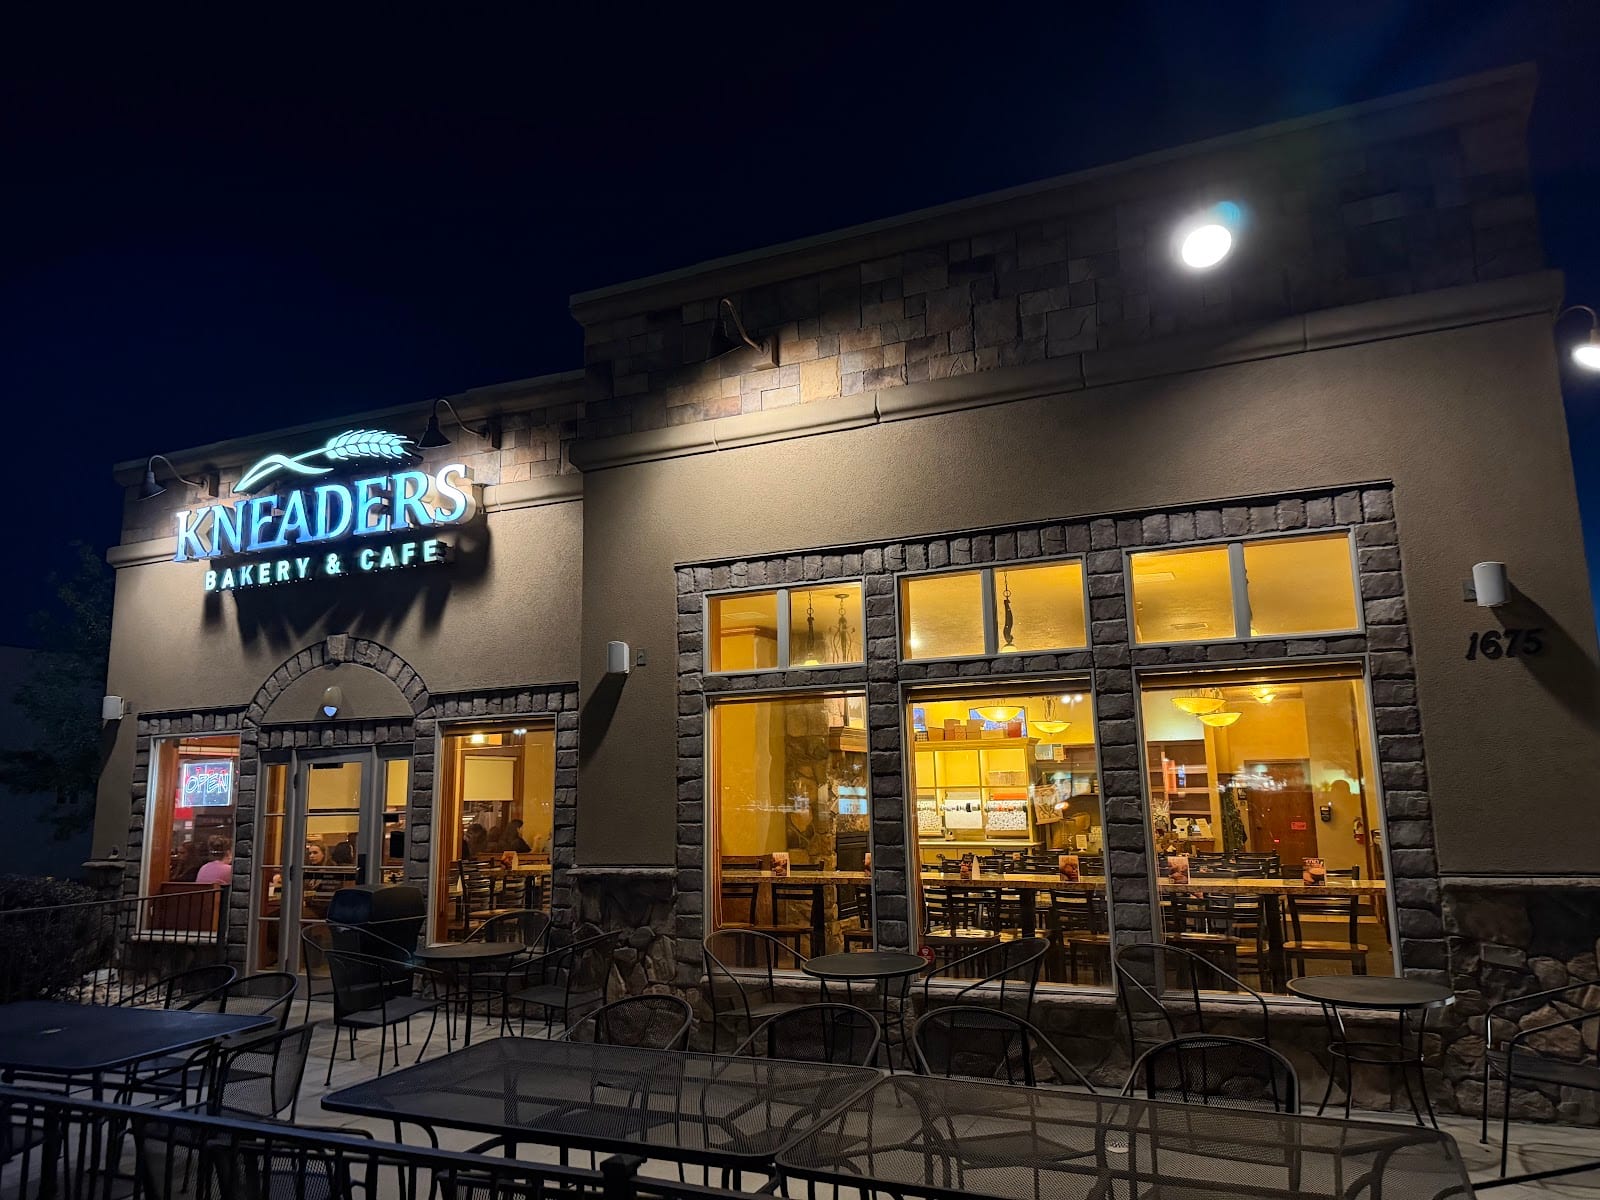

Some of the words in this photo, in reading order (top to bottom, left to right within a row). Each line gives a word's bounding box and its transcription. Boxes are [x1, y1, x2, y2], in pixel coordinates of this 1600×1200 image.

[171, 463, 471, 562] KNEADERS
[205, 557, 311, 592] BAKERY
[325, 553, 342, 576] &
[360, 540, 439, 570] CAFE
[1465, 628, 1544, 661] 1675
[186, 773, 230, 794] OPEN
